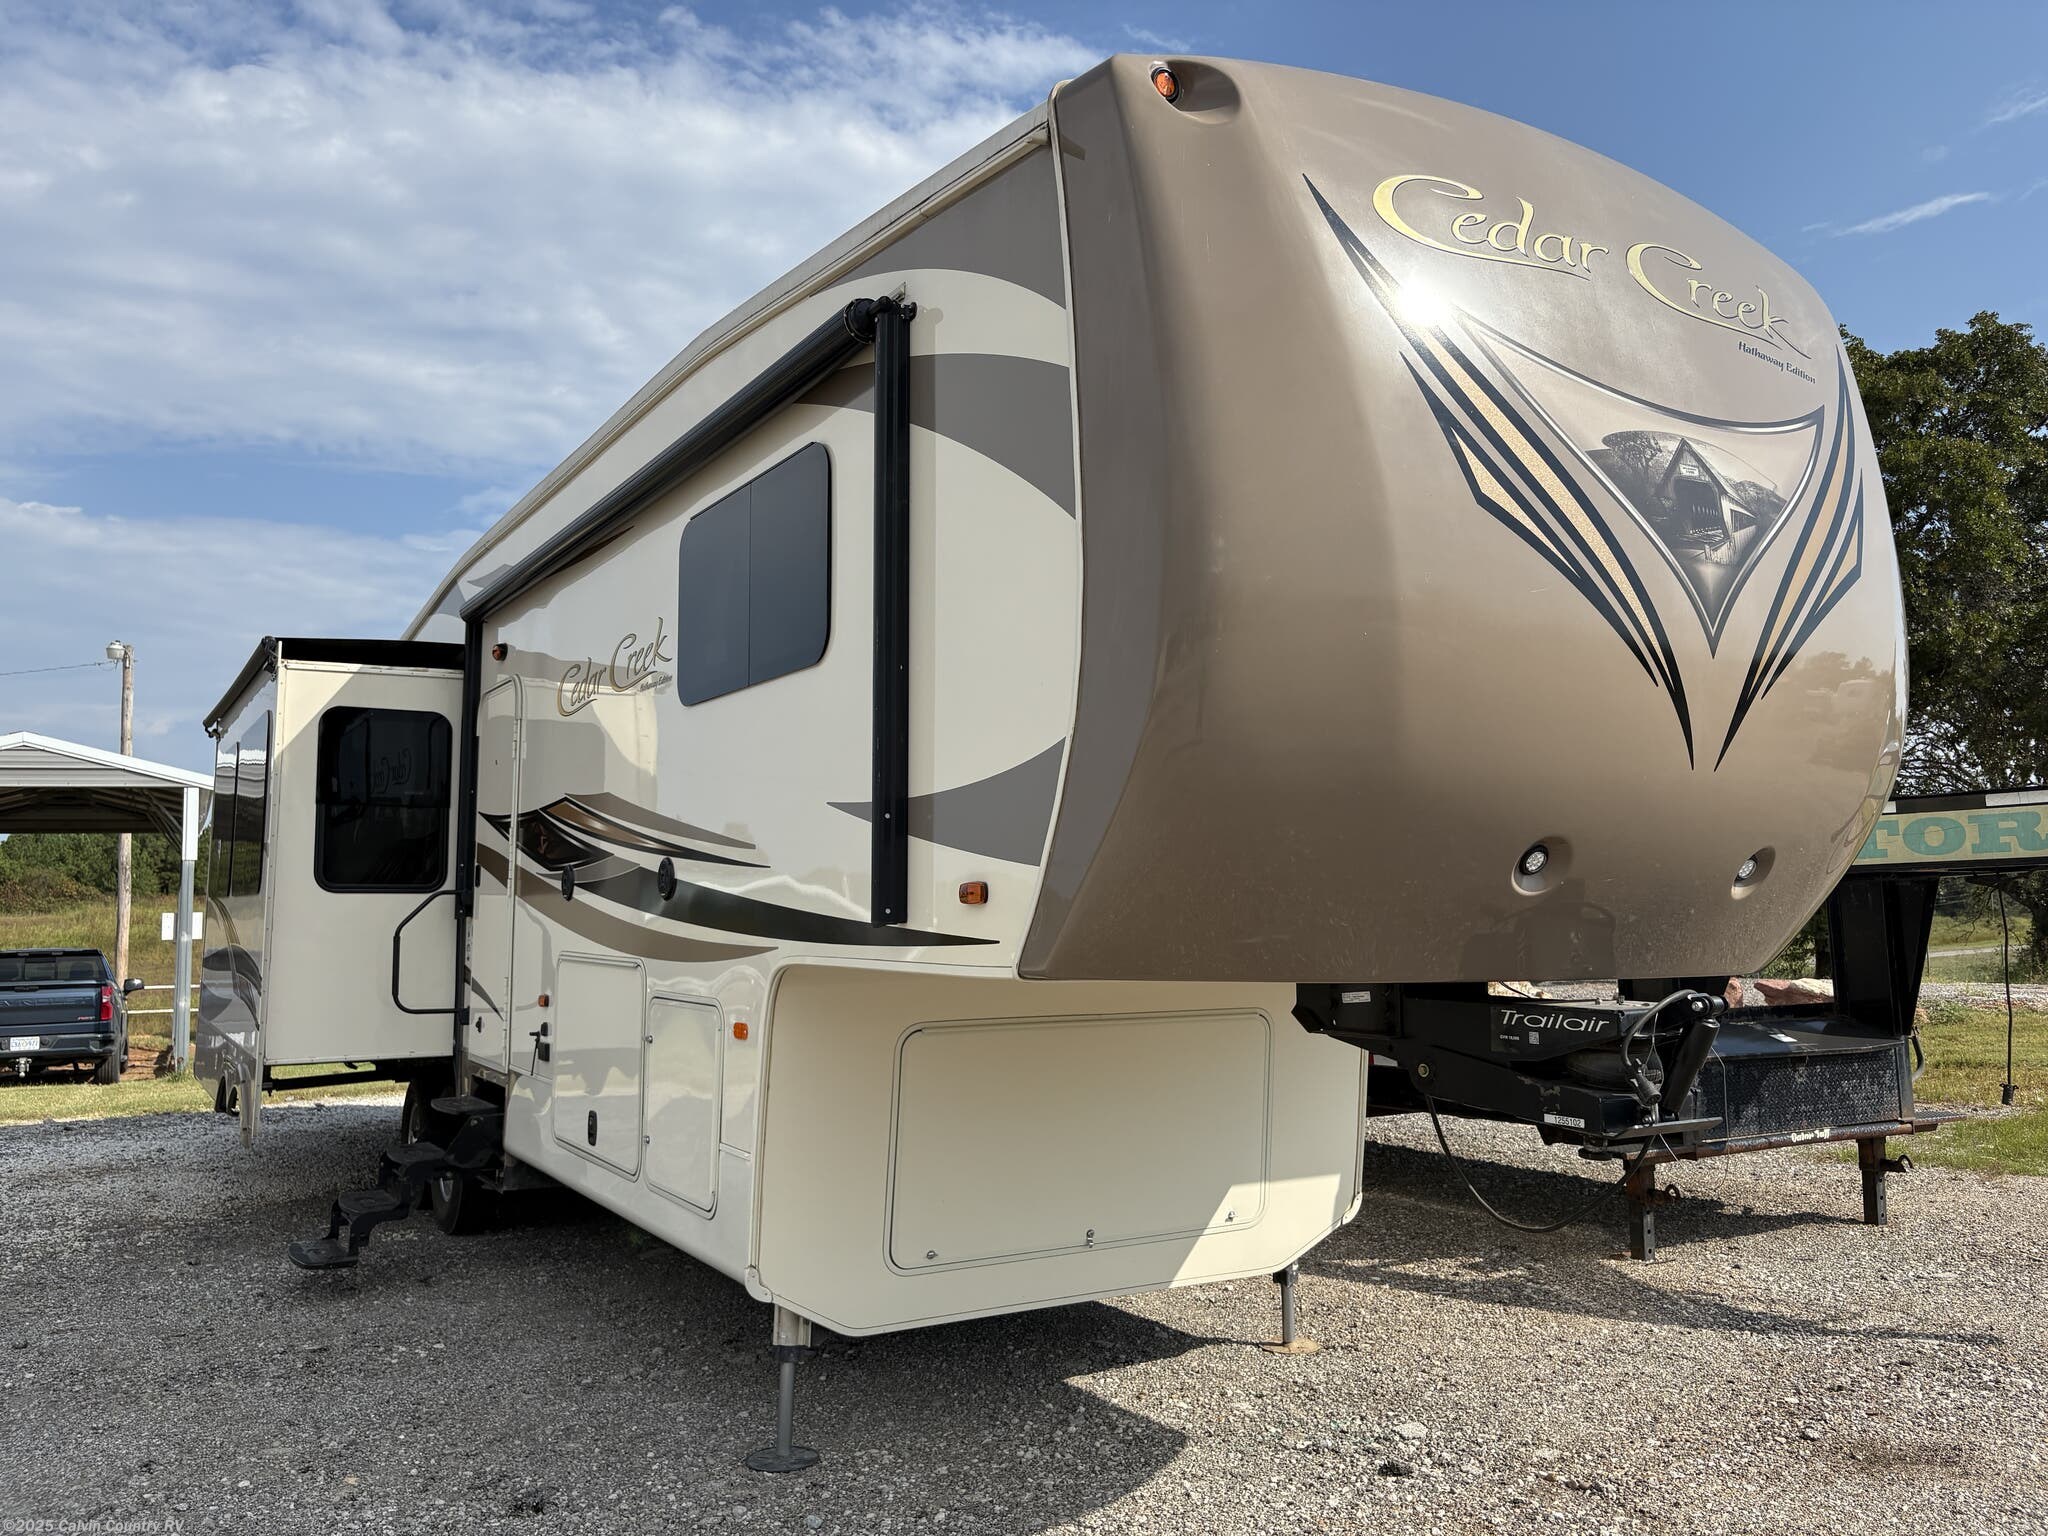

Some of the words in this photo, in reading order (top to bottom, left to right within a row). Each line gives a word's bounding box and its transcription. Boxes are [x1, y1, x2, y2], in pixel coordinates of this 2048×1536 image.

[1372, 173, 1610, 281] Cedar
[1625, 242, 1812, 360] Creek
[1737, 340, 1785, 373] Hathaway
[1786, 361, 1817, 385] Edition
[557, 656, 607, 717] Cedar
[609, 616, 673, 693] Creek
[1500, 1009, 1611, 1033] Trailair
